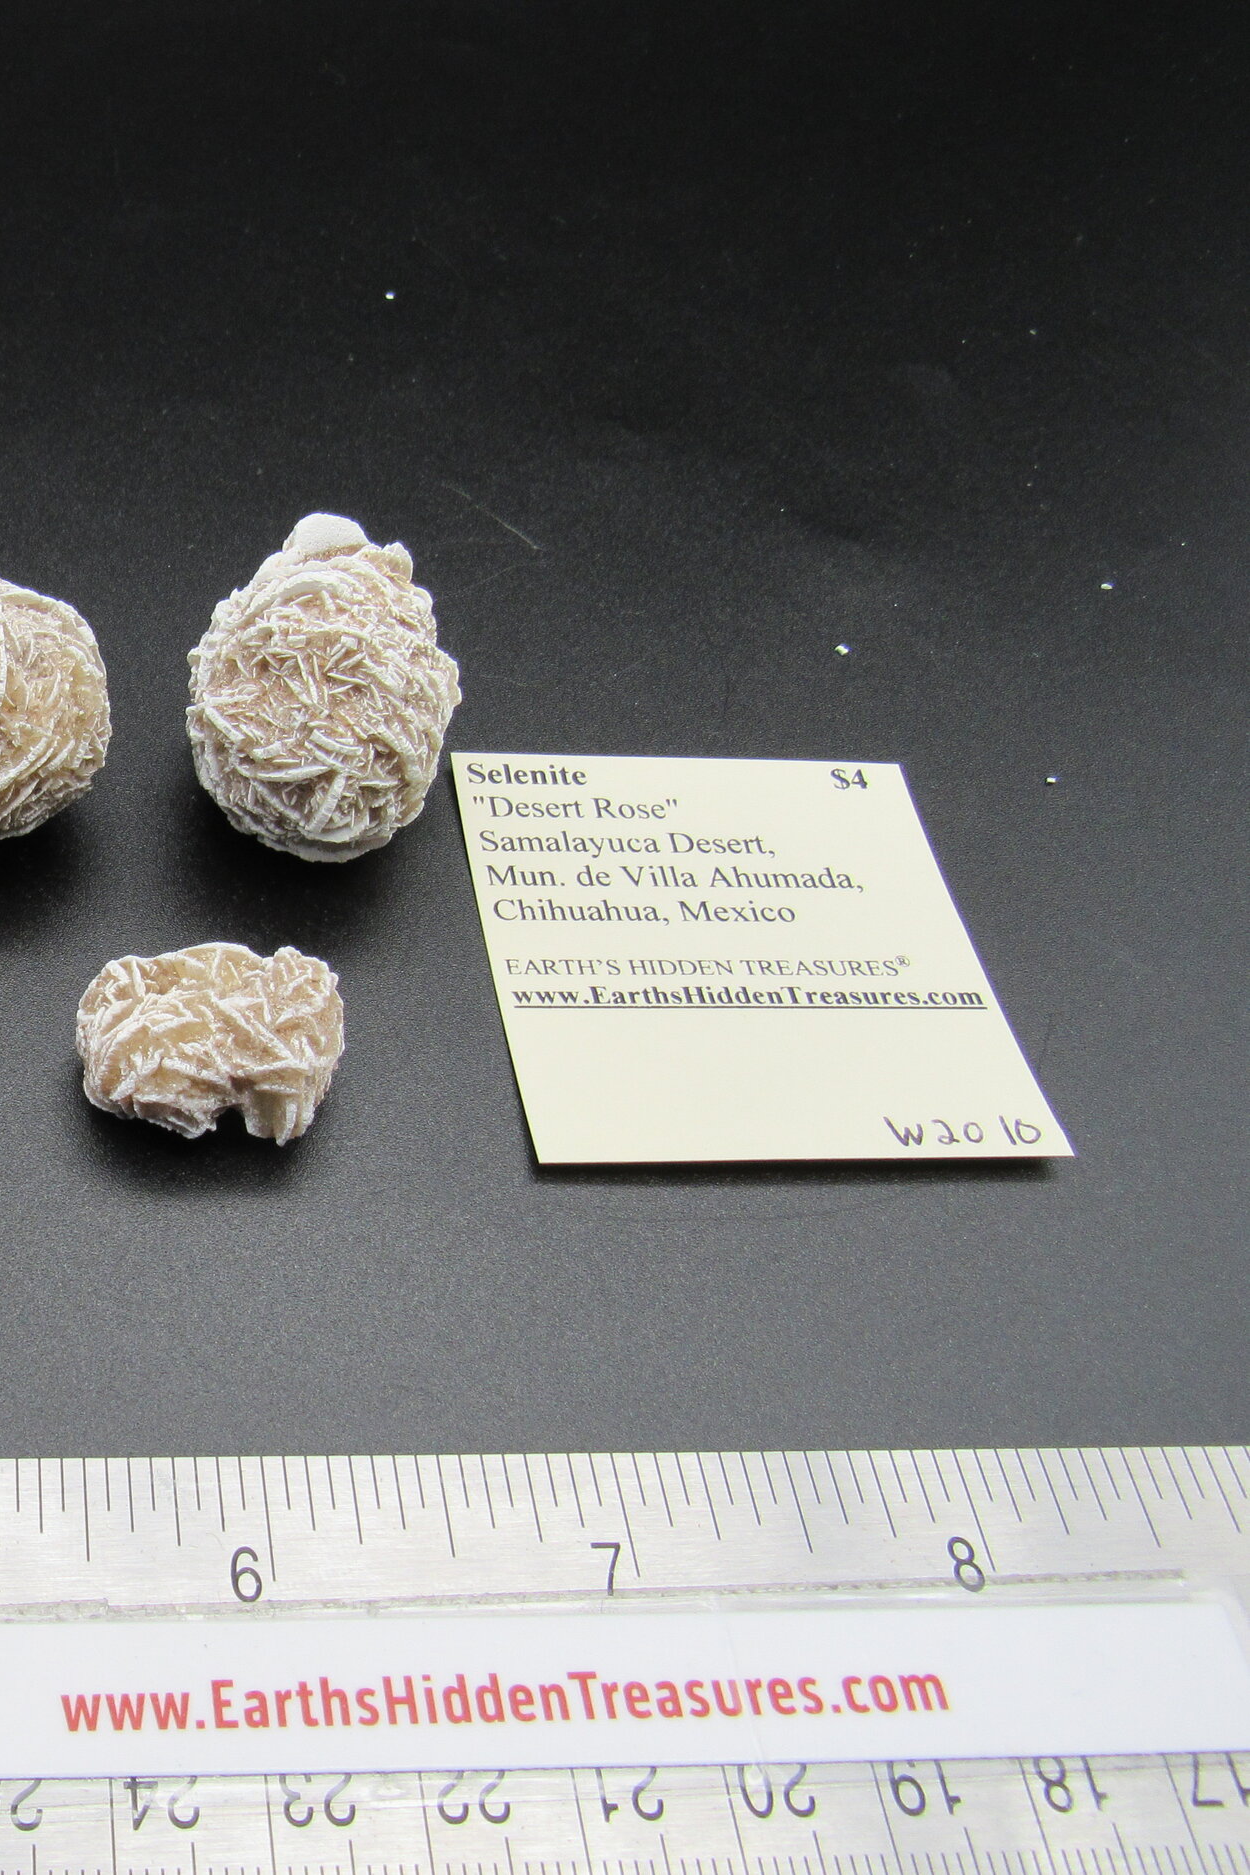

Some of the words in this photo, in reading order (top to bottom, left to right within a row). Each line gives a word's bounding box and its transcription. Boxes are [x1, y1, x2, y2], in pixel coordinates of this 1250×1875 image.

[466, 762, 587, 786] Selenite
[830, 768, 868, 790] $4
[472, 795, 585, 819] "Desert
[592, 797, 678, 820] Rose"
[479, 829, 661, 859] Samalayuca
[667, 832, 776, 858] Desert,
[486, 864, 566, 887] Mun.
[576, 864, 611, 887] de
[619, 865, 699, 888] Villa
[709, 865, 864, 893] Ahumada,
[493, 898, 670, 926] Chihuahua,
[677, 900, 796, 923] Mexico
[505, 958, 621, 976] EARTH'S
[628, 959, 734, 976] HIDDEN
[511, 985, 984, 1006] www.EarthsHiddenTreasures.com
[230, 1546, 263, 1603] 6
[589, 1541, 623, 1597] 7
[946, 1536, 987, 1593] 8
[60, 1671, 951, 1732] www.EarthsHiddenTreasures.com
